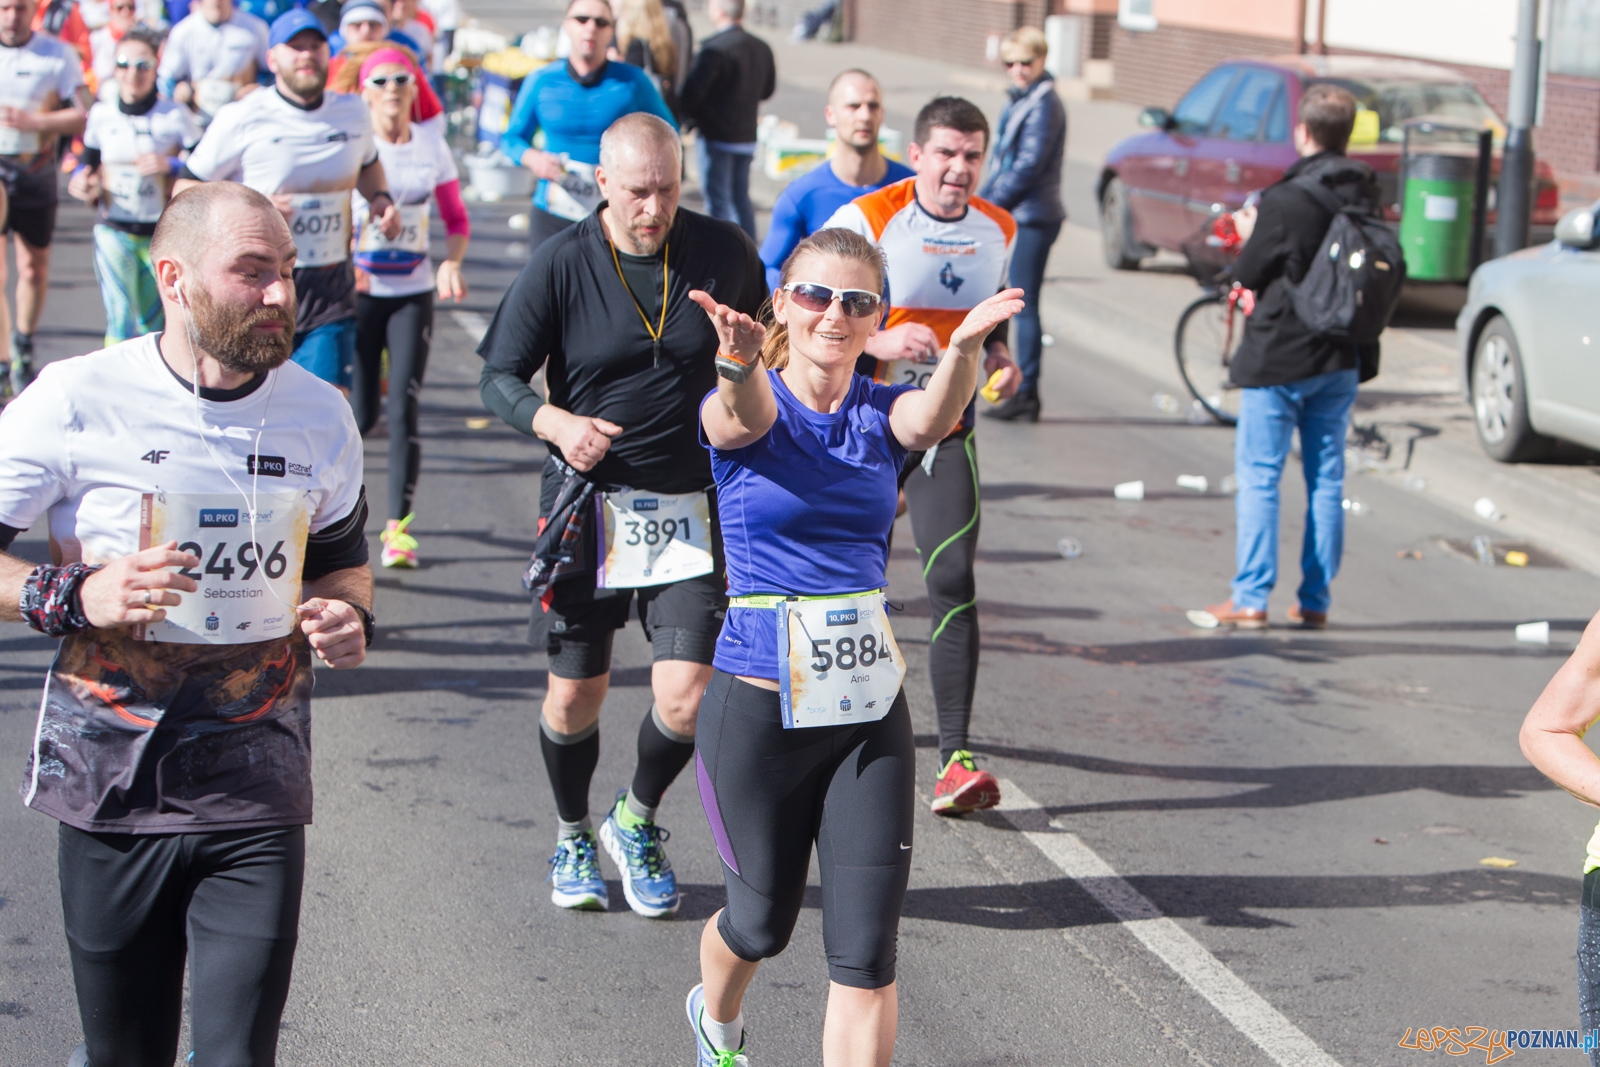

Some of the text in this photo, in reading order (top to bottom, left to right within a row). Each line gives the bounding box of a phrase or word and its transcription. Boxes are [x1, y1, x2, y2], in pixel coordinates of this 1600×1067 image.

[292, 212, 341, 235] 6073
[904, 369, 933, 391] 20
[141, 449, 170, 464] 4F
[264, 461, 283, 471] PKO
[203, 513, 236, 523] 10. PKO
[624, 517, 691, 546] 3891
[177, 540, 287, 581] 2496
[203, 587, 263, 599] Sebastian
[829, 614, 839, 622] 10.
[840, 612, 856, 621] PKO
[236, 621, 251, 631] 4F
[810, 631, 893, 672] 5884
[850, 673, 870, 684] Ania
[864, 700, 877, 709] 4F
